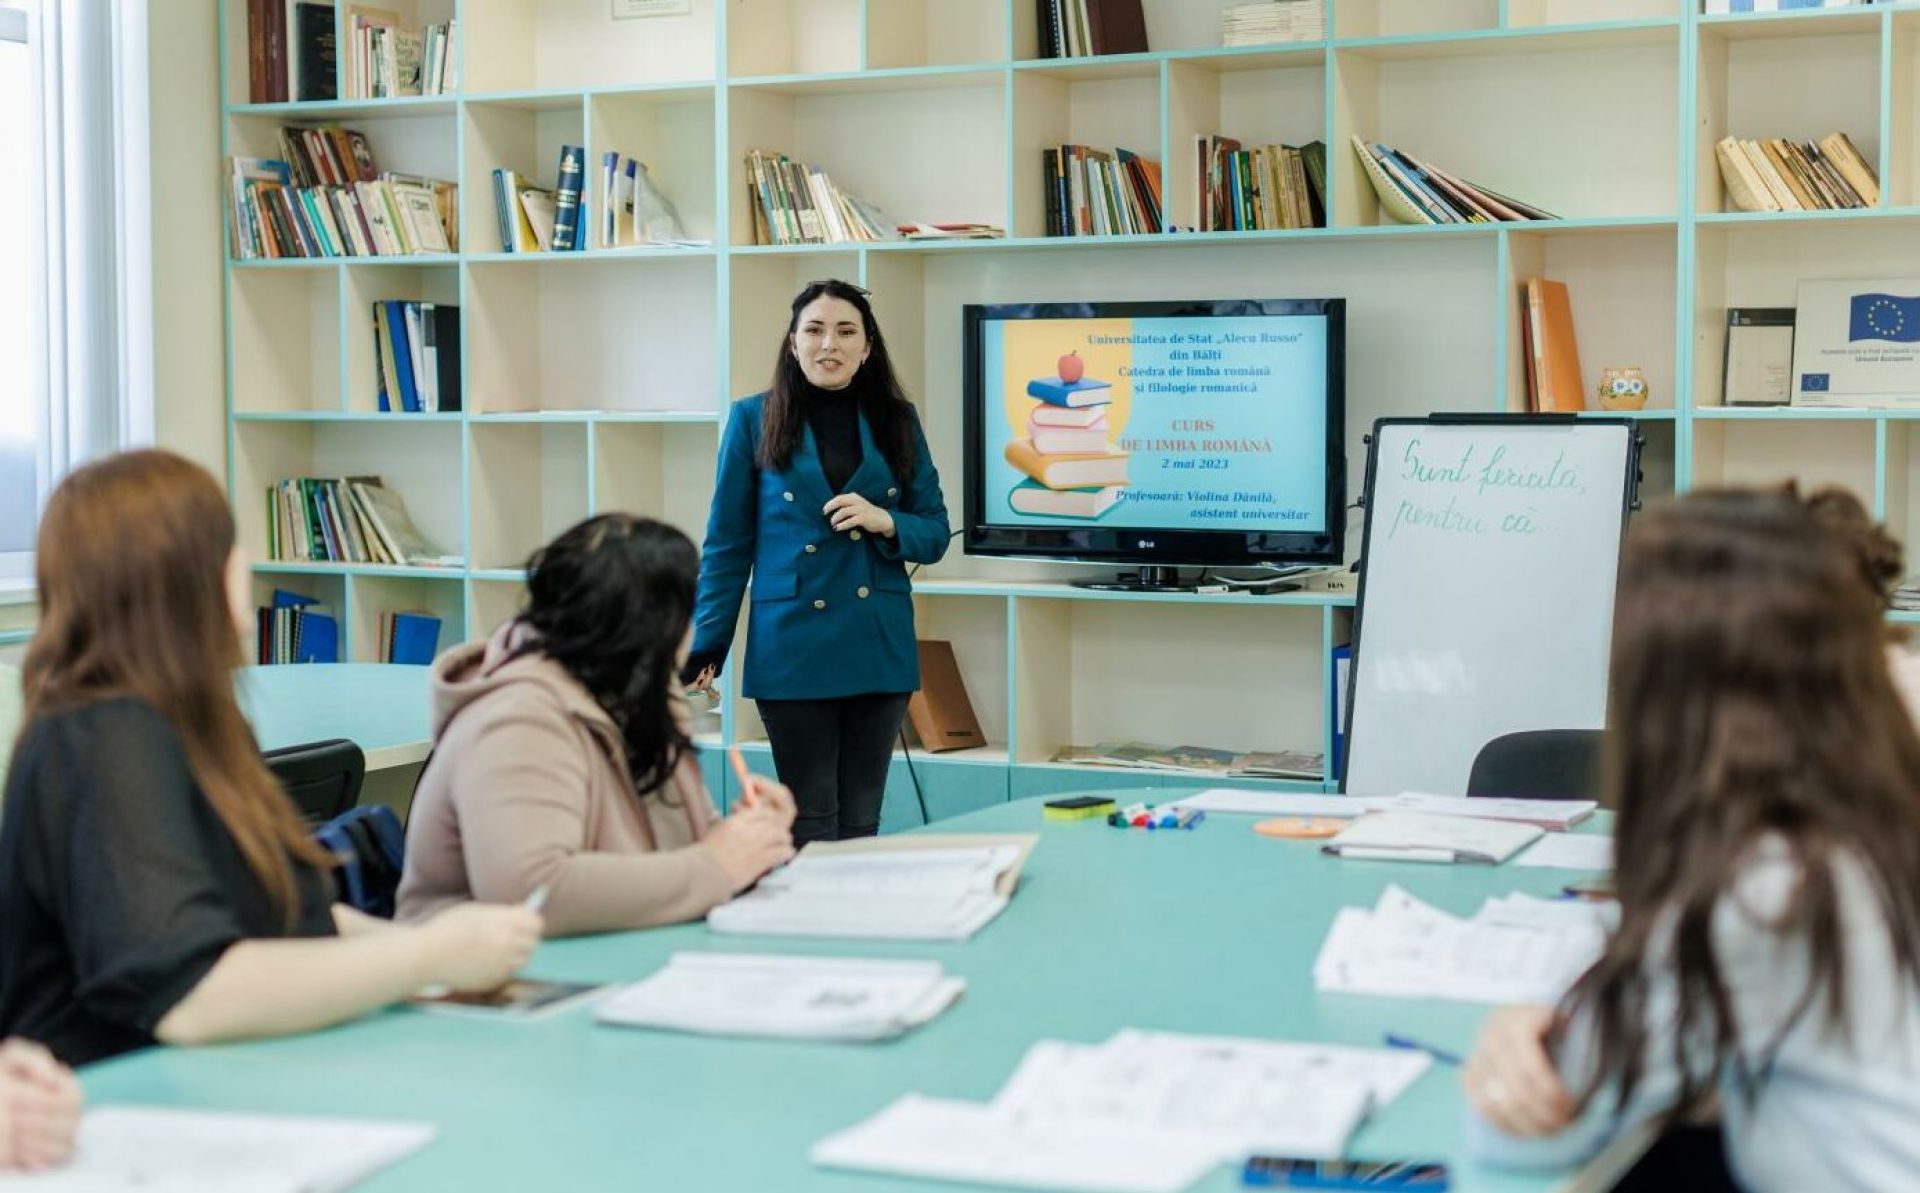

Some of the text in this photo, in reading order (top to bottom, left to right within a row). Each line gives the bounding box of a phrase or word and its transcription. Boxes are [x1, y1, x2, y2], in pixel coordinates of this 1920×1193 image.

[1088, 334, 1166, 344] Universitatea
[1170, 334, 1184, 344] de
[1188, 334, 1211, 344] Stat
[1170, 350, 1189, 360] din
[1118, 365, 1271, 377] Catedra de limba română
[1149, 382, 1196, 395] filologie
[1200, 382, 1258, 393] romanică
[1171, 419, 1215, 432] CURS
[1121, 439, 1138, 451] DE
[1147, 439, 1196, 451] LIMBA
[1161, 458, 1229, 470] 2 mai 2023
[1402, 439, 1474, 482] Sunt
[1187, 490, 1228, 502] Violina
[1190, 508, 1311, 520] asistent universitar
[1388, 495, 1485, 540] pentru
